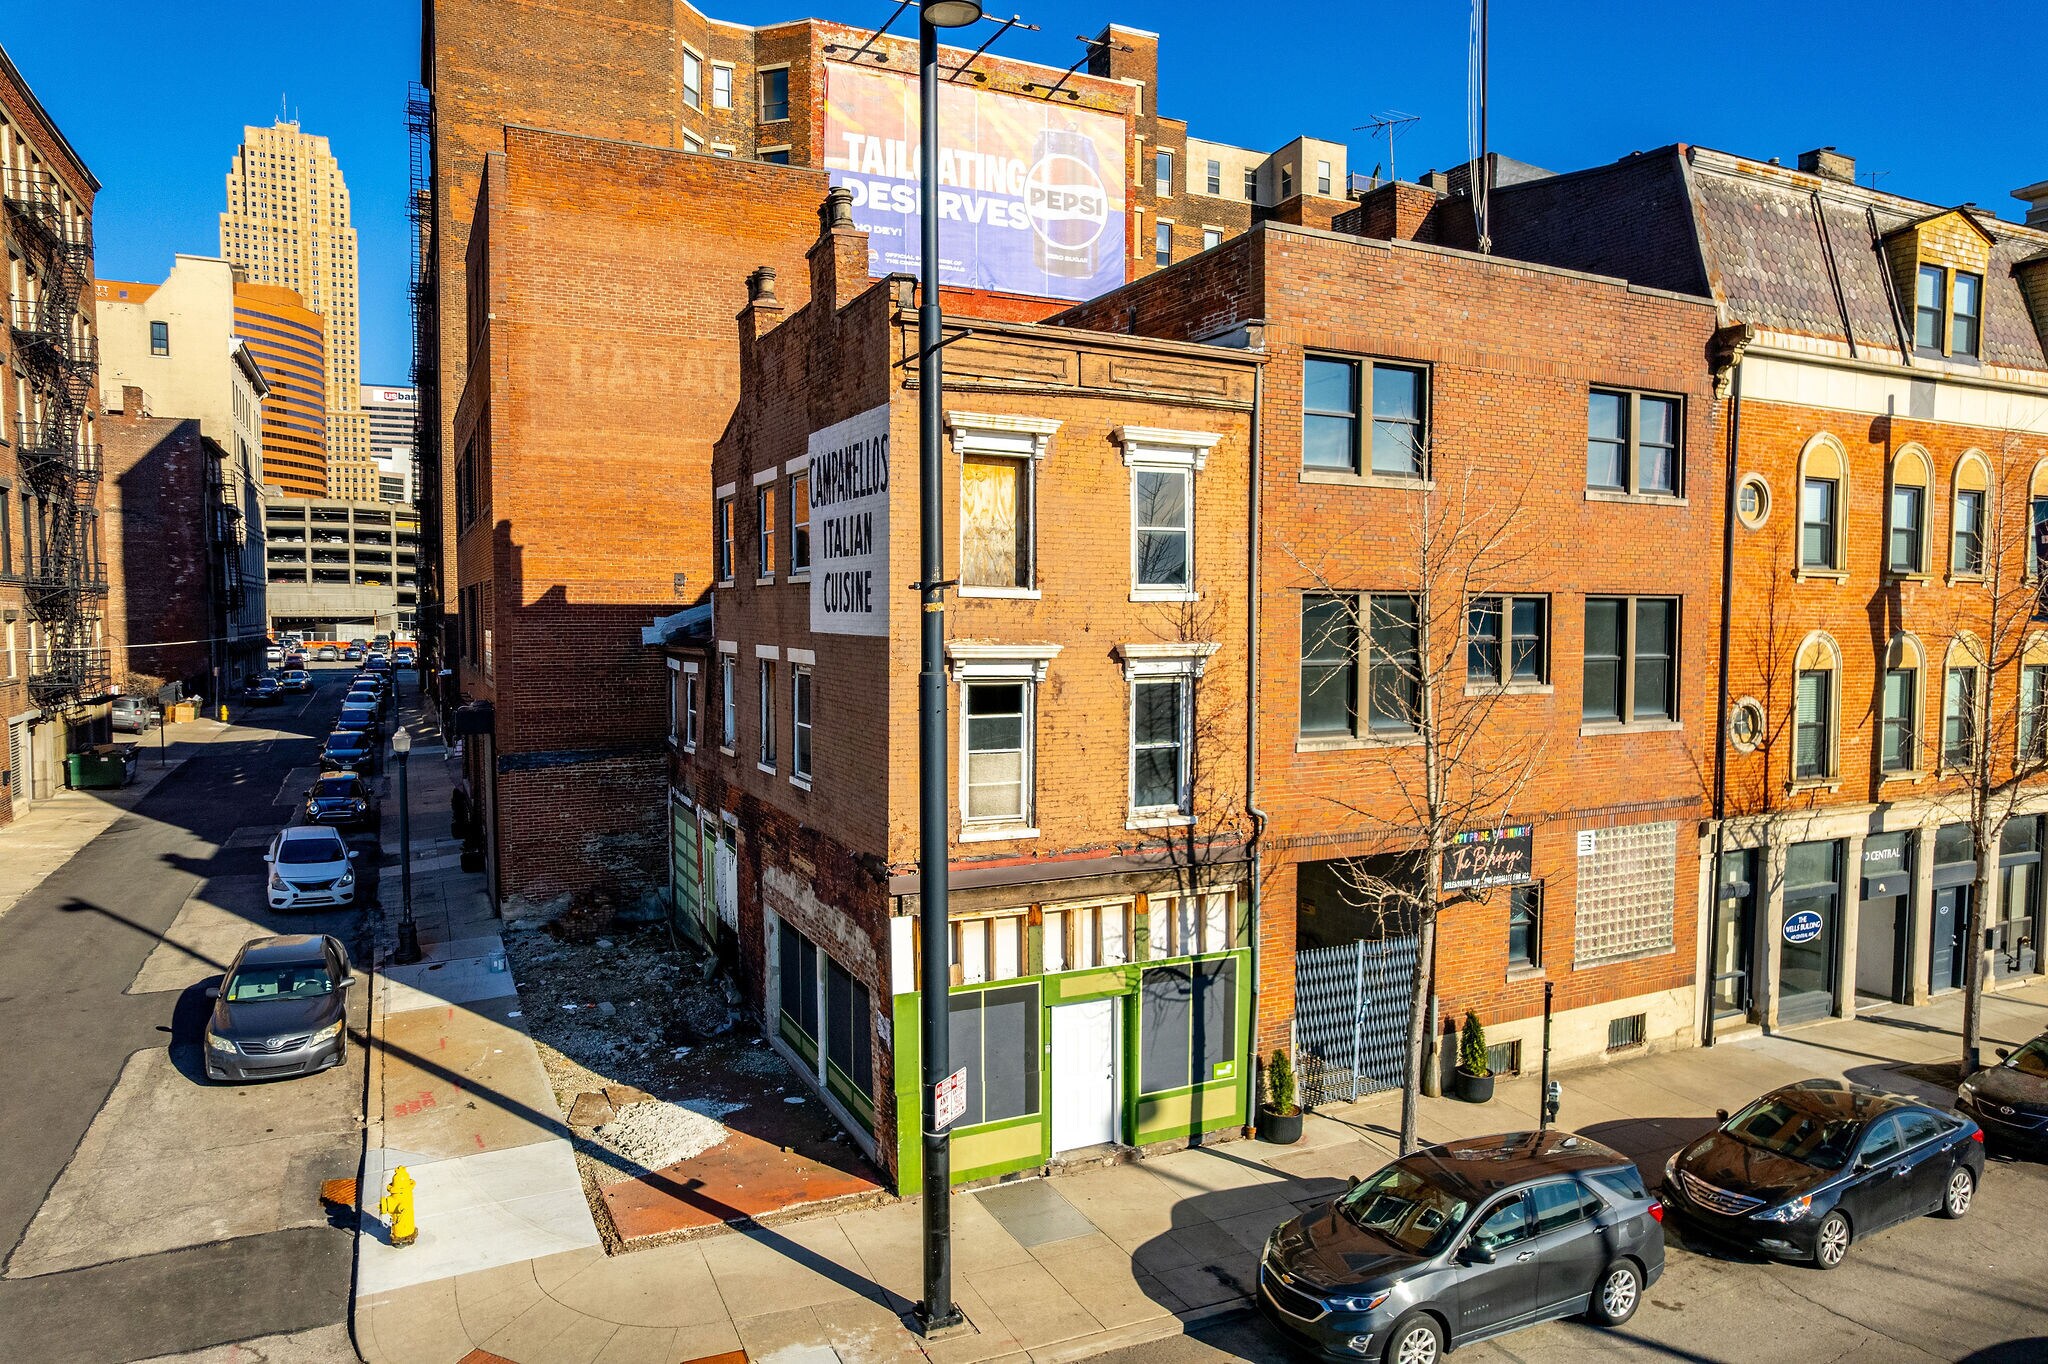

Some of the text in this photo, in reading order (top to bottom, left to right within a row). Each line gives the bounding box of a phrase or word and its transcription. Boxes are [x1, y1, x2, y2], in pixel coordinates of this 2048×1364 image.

[841, 176, 1031, 231] DESRVES
[1030, 187, 1102, 216] PEPSI
[810, 433, 889, 509] CAMPANELLOS
[823, 512, 873, 559] ITALIAN
[823, 570, 873, 613] CUISINE
[1452, 844, 1472, 880] The
[1870, 847, 1901, 861] CENTRAL
[1798, 915, 1808, 924] THE
[1800, 920, 1821, 931] BUILDING
